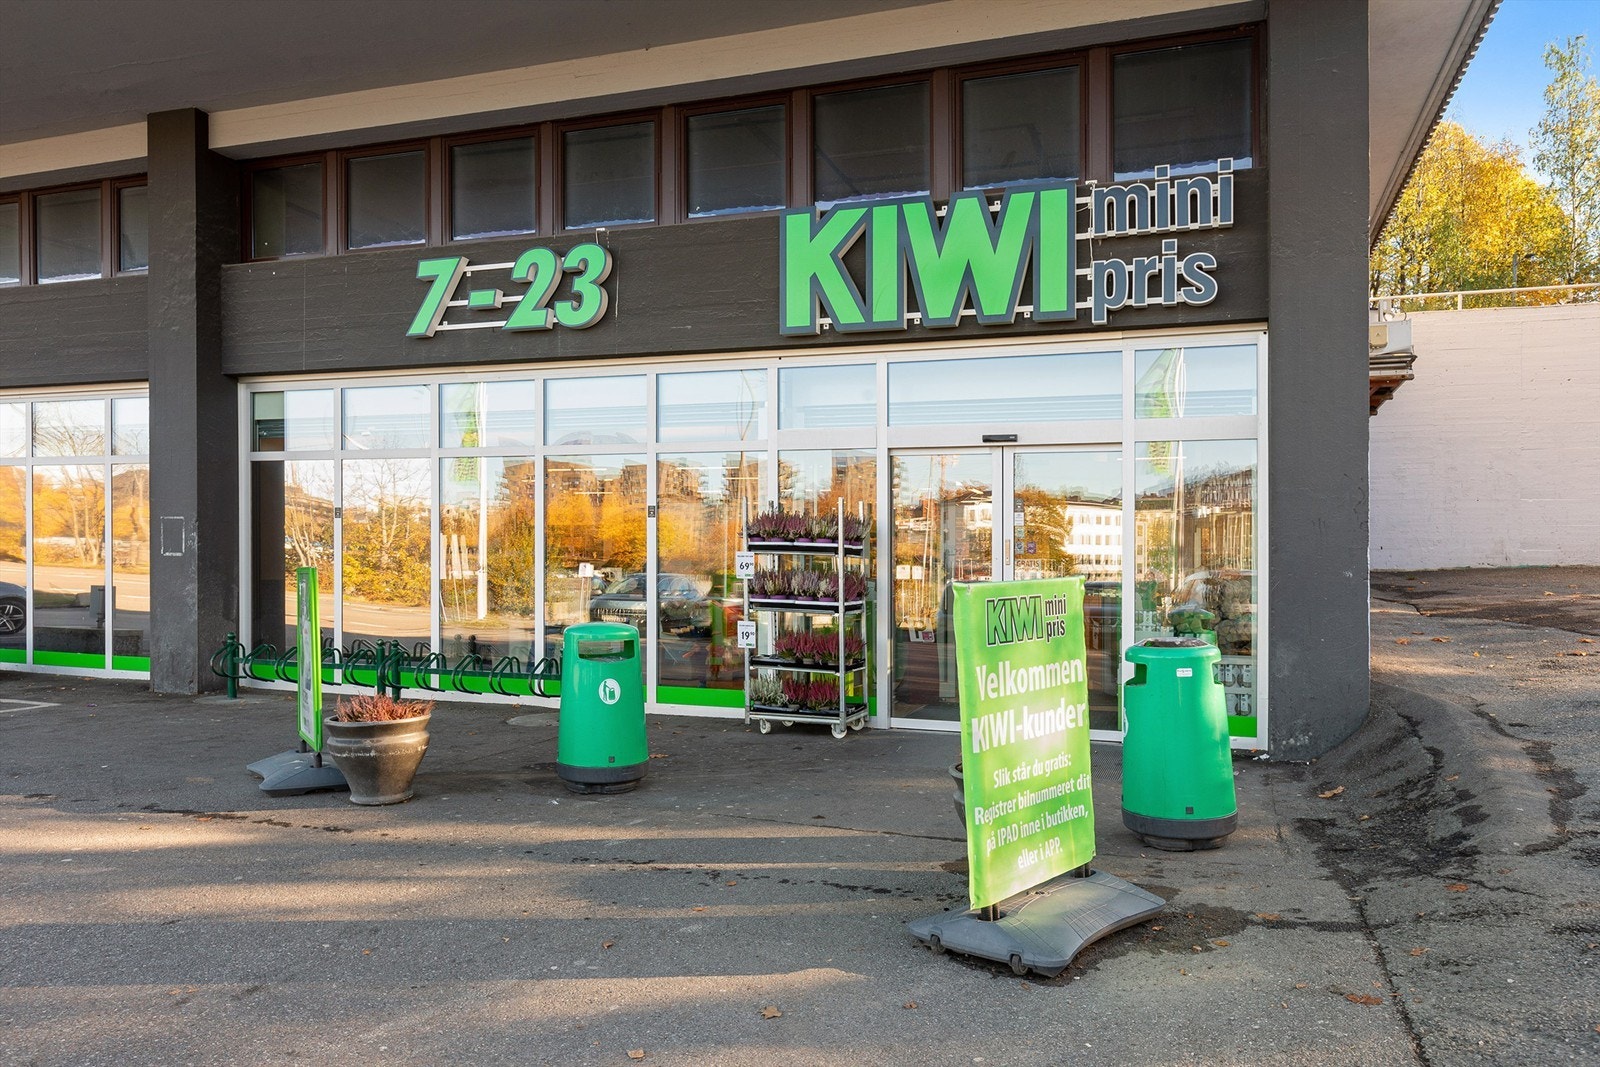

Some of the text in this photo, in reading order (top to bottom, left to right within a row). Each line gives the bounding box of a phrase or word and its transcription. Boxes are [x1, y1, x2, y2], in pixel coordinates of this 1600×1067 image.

[1092, 158, 1235, 239] mini
[780, 182, 1077, 336] KIWI
[1091, 238, 1219, 325] pris
[406, 242, 613, 338] 7-23
[986, 594, 1044, 646] KIWI
[1045, 593, 1067, 616] mini
[1046, 616, 1066, 643] pris
[976, 658, 1084, 701] Velkommen
[972, 697, 1087, 754] KIWI-kunder
[993, 752, 1072, 789] Slik står du gratis:
[974, 798, 1017, 826] Registrer
[1018, 780, 1075, 808] bilnummeret
[986, 803, 1089, 857] på IPAD inne i butikken,
[1017, 836, 1063, 869] eller i APP.
